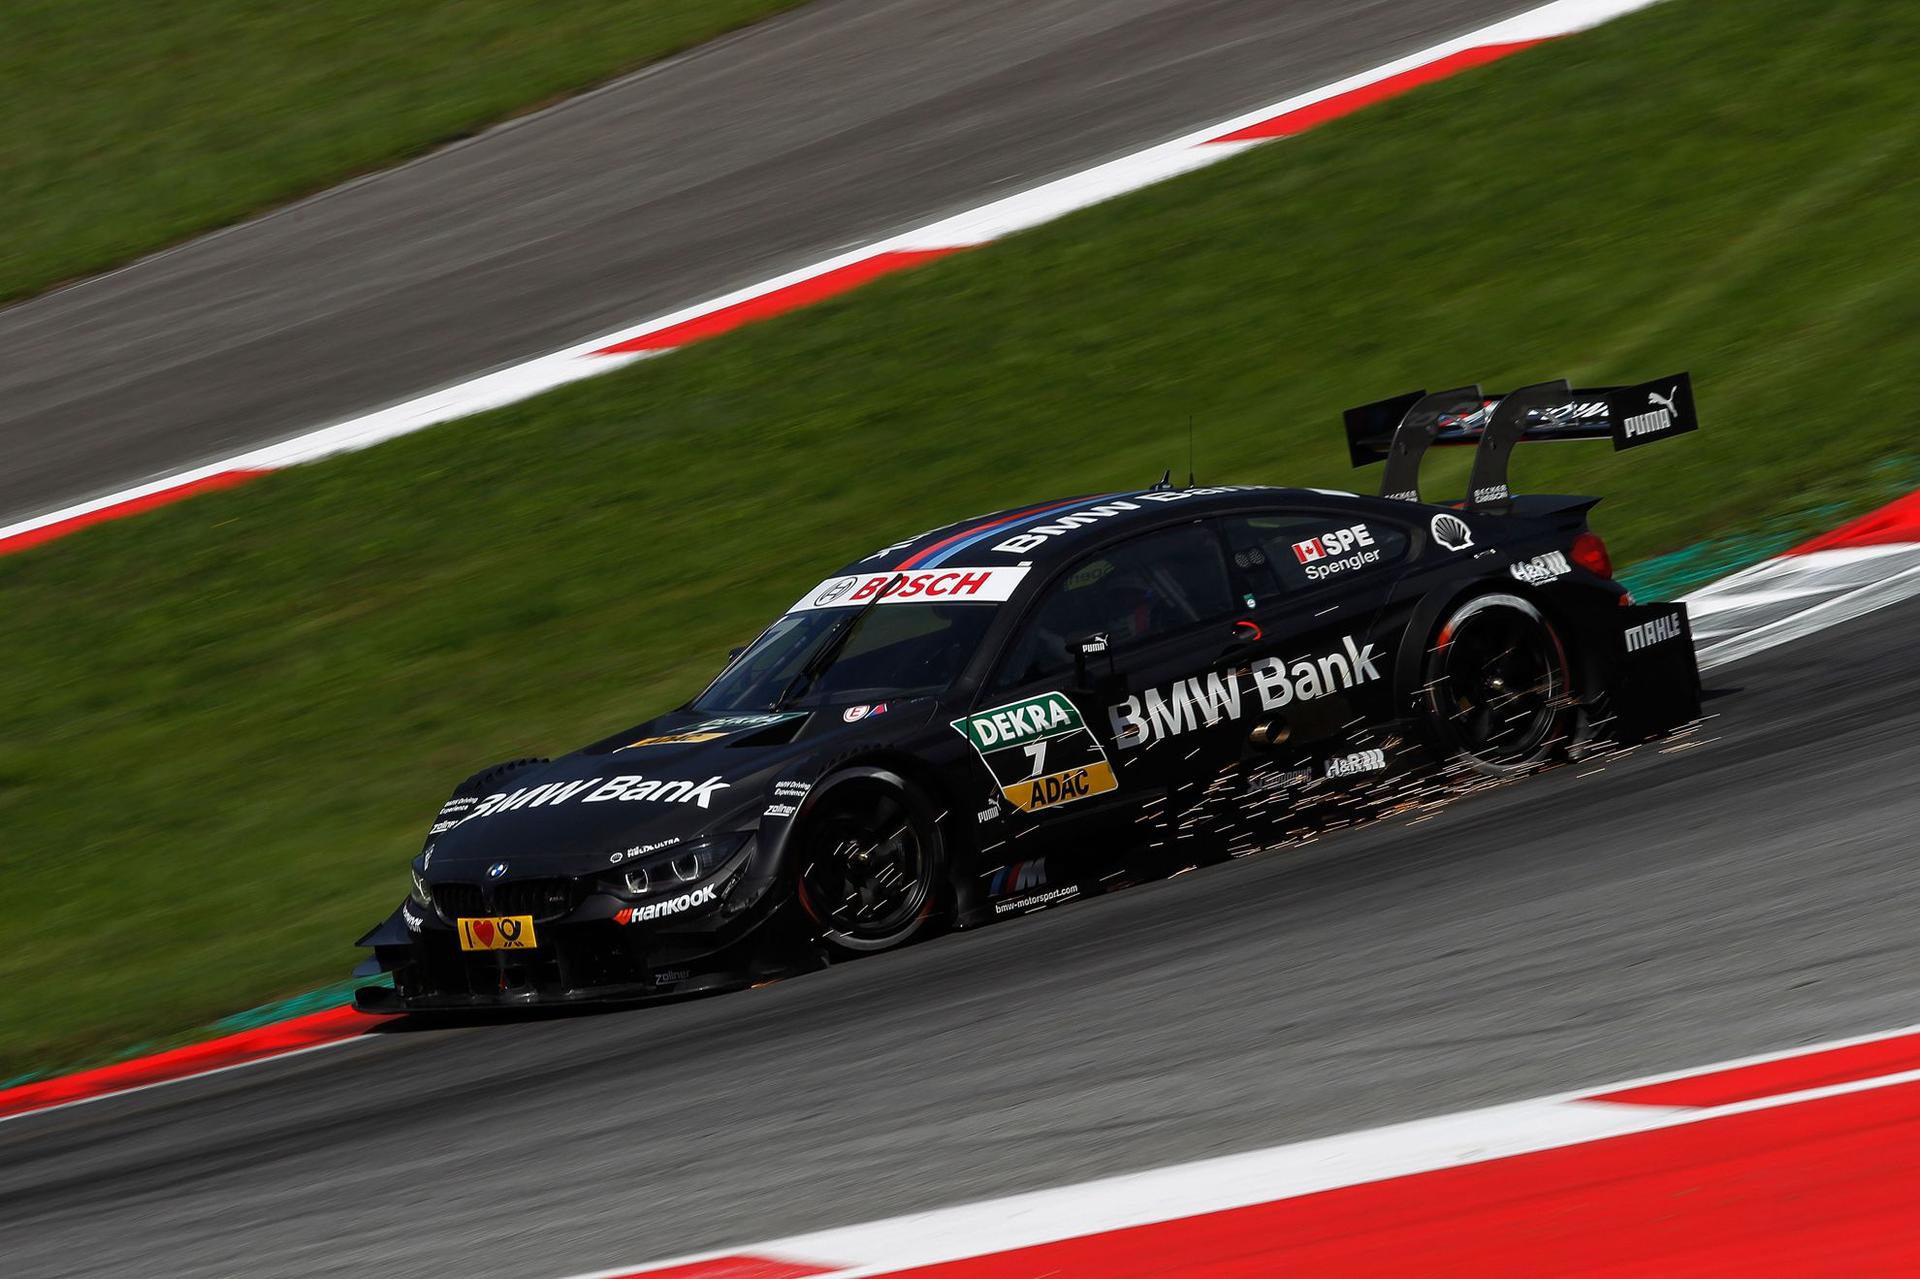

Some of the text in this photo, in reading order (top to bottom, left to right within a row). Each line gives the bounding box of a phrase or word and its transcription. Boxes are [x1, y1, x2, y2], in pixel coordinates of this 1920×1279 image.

[1624, 409, 1672, 438] PUMA
[991, 500, 1142, 553] BMW
[1321, 523, 1375, 556] SPE
[1305, 549, 1380, 580] Spengler
[849, 571, 993, 600] BOSCH
[1082, 642, 1105, 653] PUMA
[1624, 611, 1681, 652] MAHLE
[1107, 635, 1381, 750] BMW Bank
[972, 699, 1072, 747] DEKRA
[1024, 741, 1047, 777] 7
[452, 775, 731, 829] BMW Bank
[1030, 769, 1090, 809] ADAC
[978, 806, 1000, 823] PUMA
[654, 837, 680, 850] ULTRA
[995, 884, 1078, 914] bmw-motorsport.com
